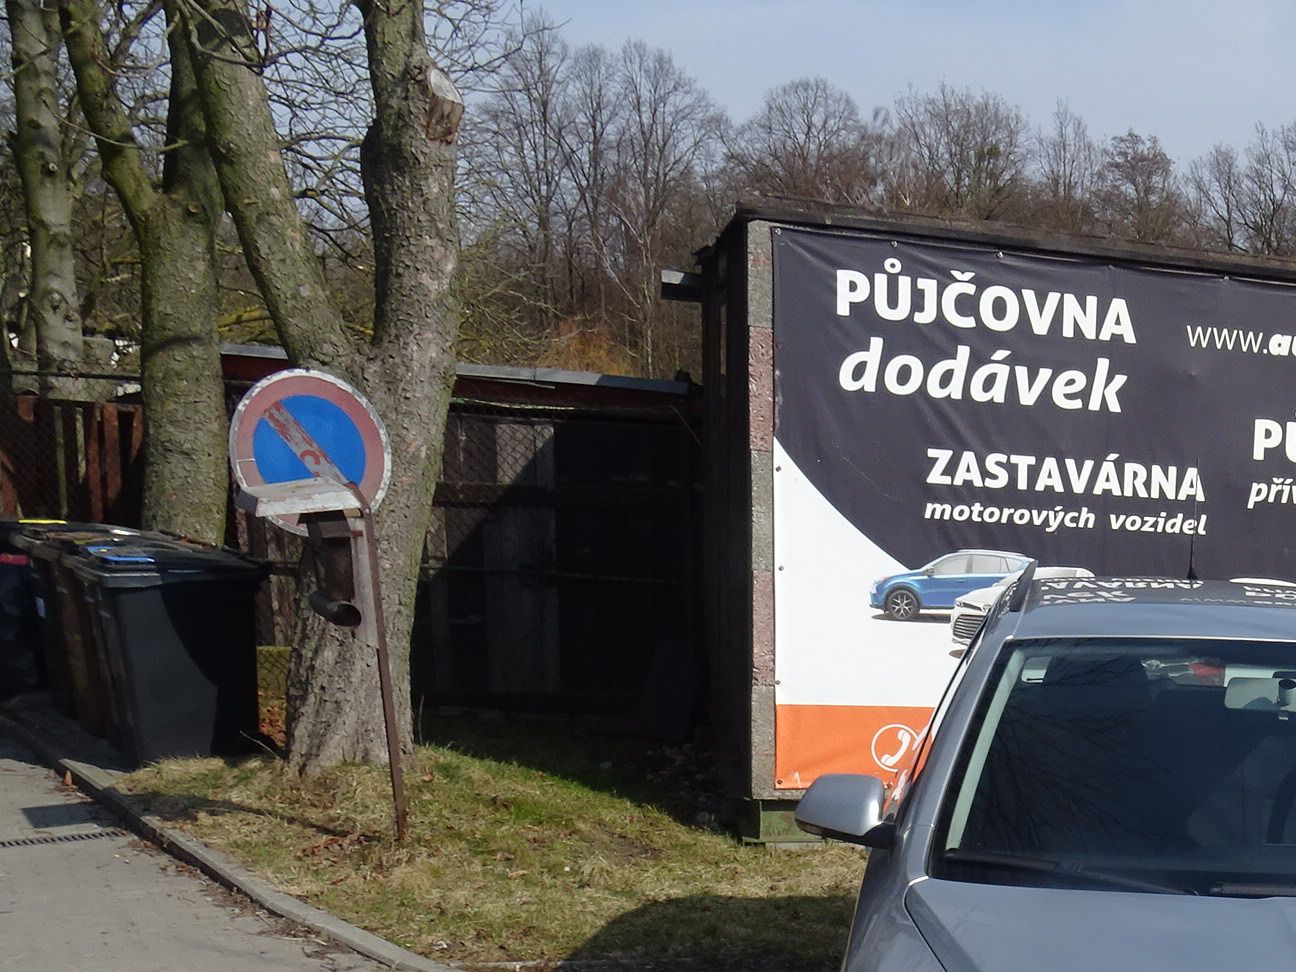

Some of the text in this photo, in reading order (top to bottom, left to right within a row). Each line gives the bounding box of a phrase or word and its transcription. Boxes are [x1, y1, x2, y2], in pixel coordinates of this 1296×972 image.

[836, 257, 1137, 345] PŮJČOVNA
[838, 336, 1128, 413] dodávek
[925, 448, 1206, 502] ZASTAVÁRNA
[924, 502, 1208, 536] motorových vozidel
